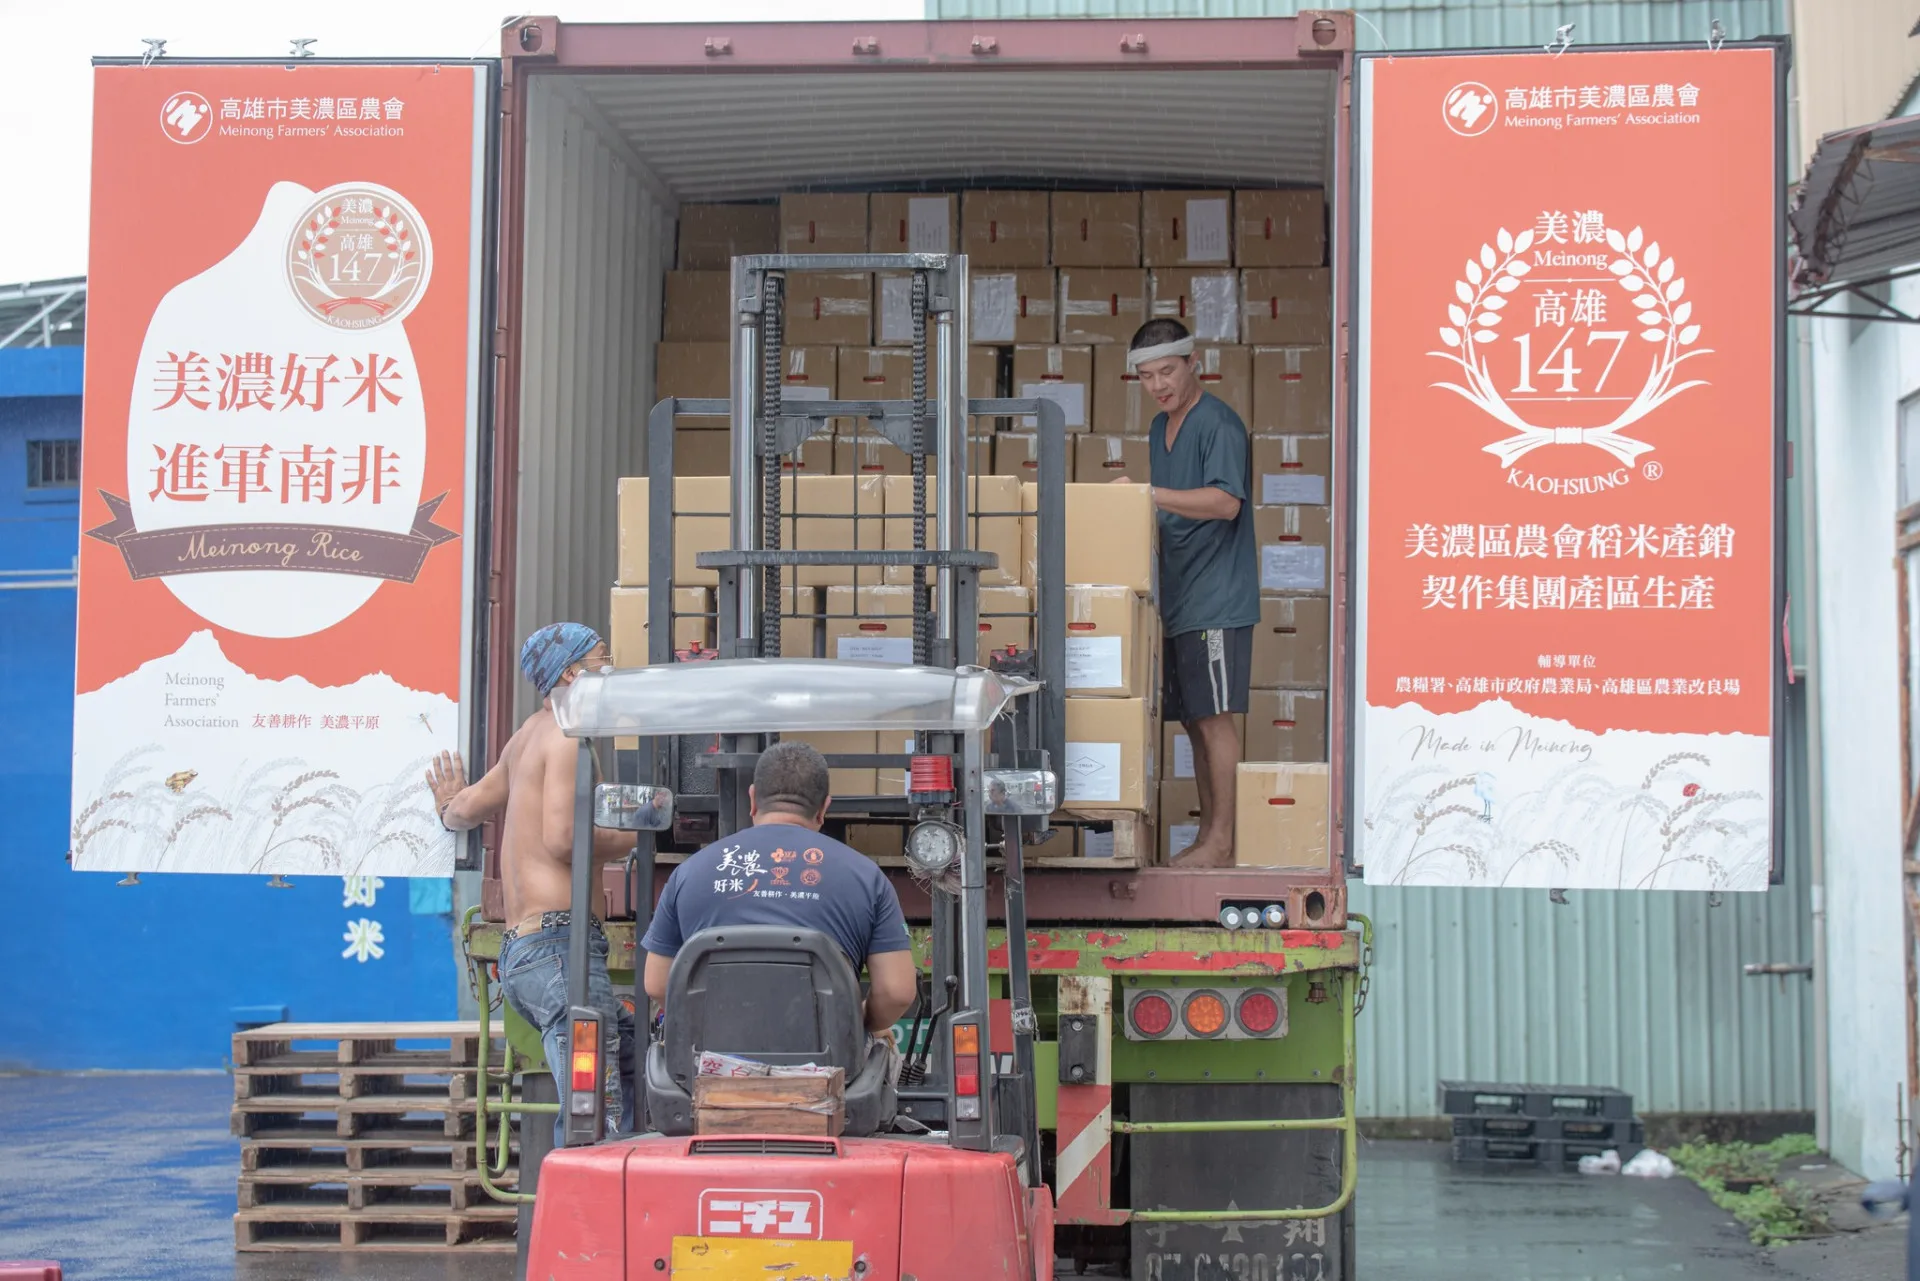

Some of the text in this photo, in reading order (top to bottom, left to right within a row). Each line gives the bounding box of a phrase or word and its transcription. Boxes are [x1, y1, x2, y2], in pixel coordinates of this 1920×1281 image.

[219, 96, 405, 120] 高雄市美濃區農會
[1504, 82, 1700, 111] 高雄市美濃區農會
[219, 124, 404, 140] Meinong Farmers' Association
[1504, 112, 1700, 130] Meinong Farmers' Association
[342, 198, 374, 214] 美濃
[1534, 210, 1606, 245] 美濃
[340, 234, 374, 251] 高雄
[329, 251, 382, 282] 147
[1534, 250, 1608, 270] Meinong
[1532, 288, 1608, 328] 高雄
[326, 314, 382, 329] KAOHSIUNG
[1510, 327, 1630, 393] 147
[152, 350, 404, 412] 美濃好米
[148, 442, 401, 505] 進軍南非
[1506, 467, 1630, 496] KAOHSIUNG
[177, 532, 364, 566] Meinong Rice
[1404, 522, 1736, 559] 美濃區農會稻米產銷
[1422, 574, 1716, 610] 契作集團產區生產
[1537, 654, 1596, 668] 輔導單位
[165, 672, 224, 691] Meinong
[164, 693, 220, 707] Farmers'
[164, 715, 239, 728] Association
[252, 714, 380, 730] 友善耕作 美濃平原
[1398, 725, 1592, 762] Made in Meinong
[716, 845, 768, 877] 美濃
[714, 878, 744, 894] 好米
